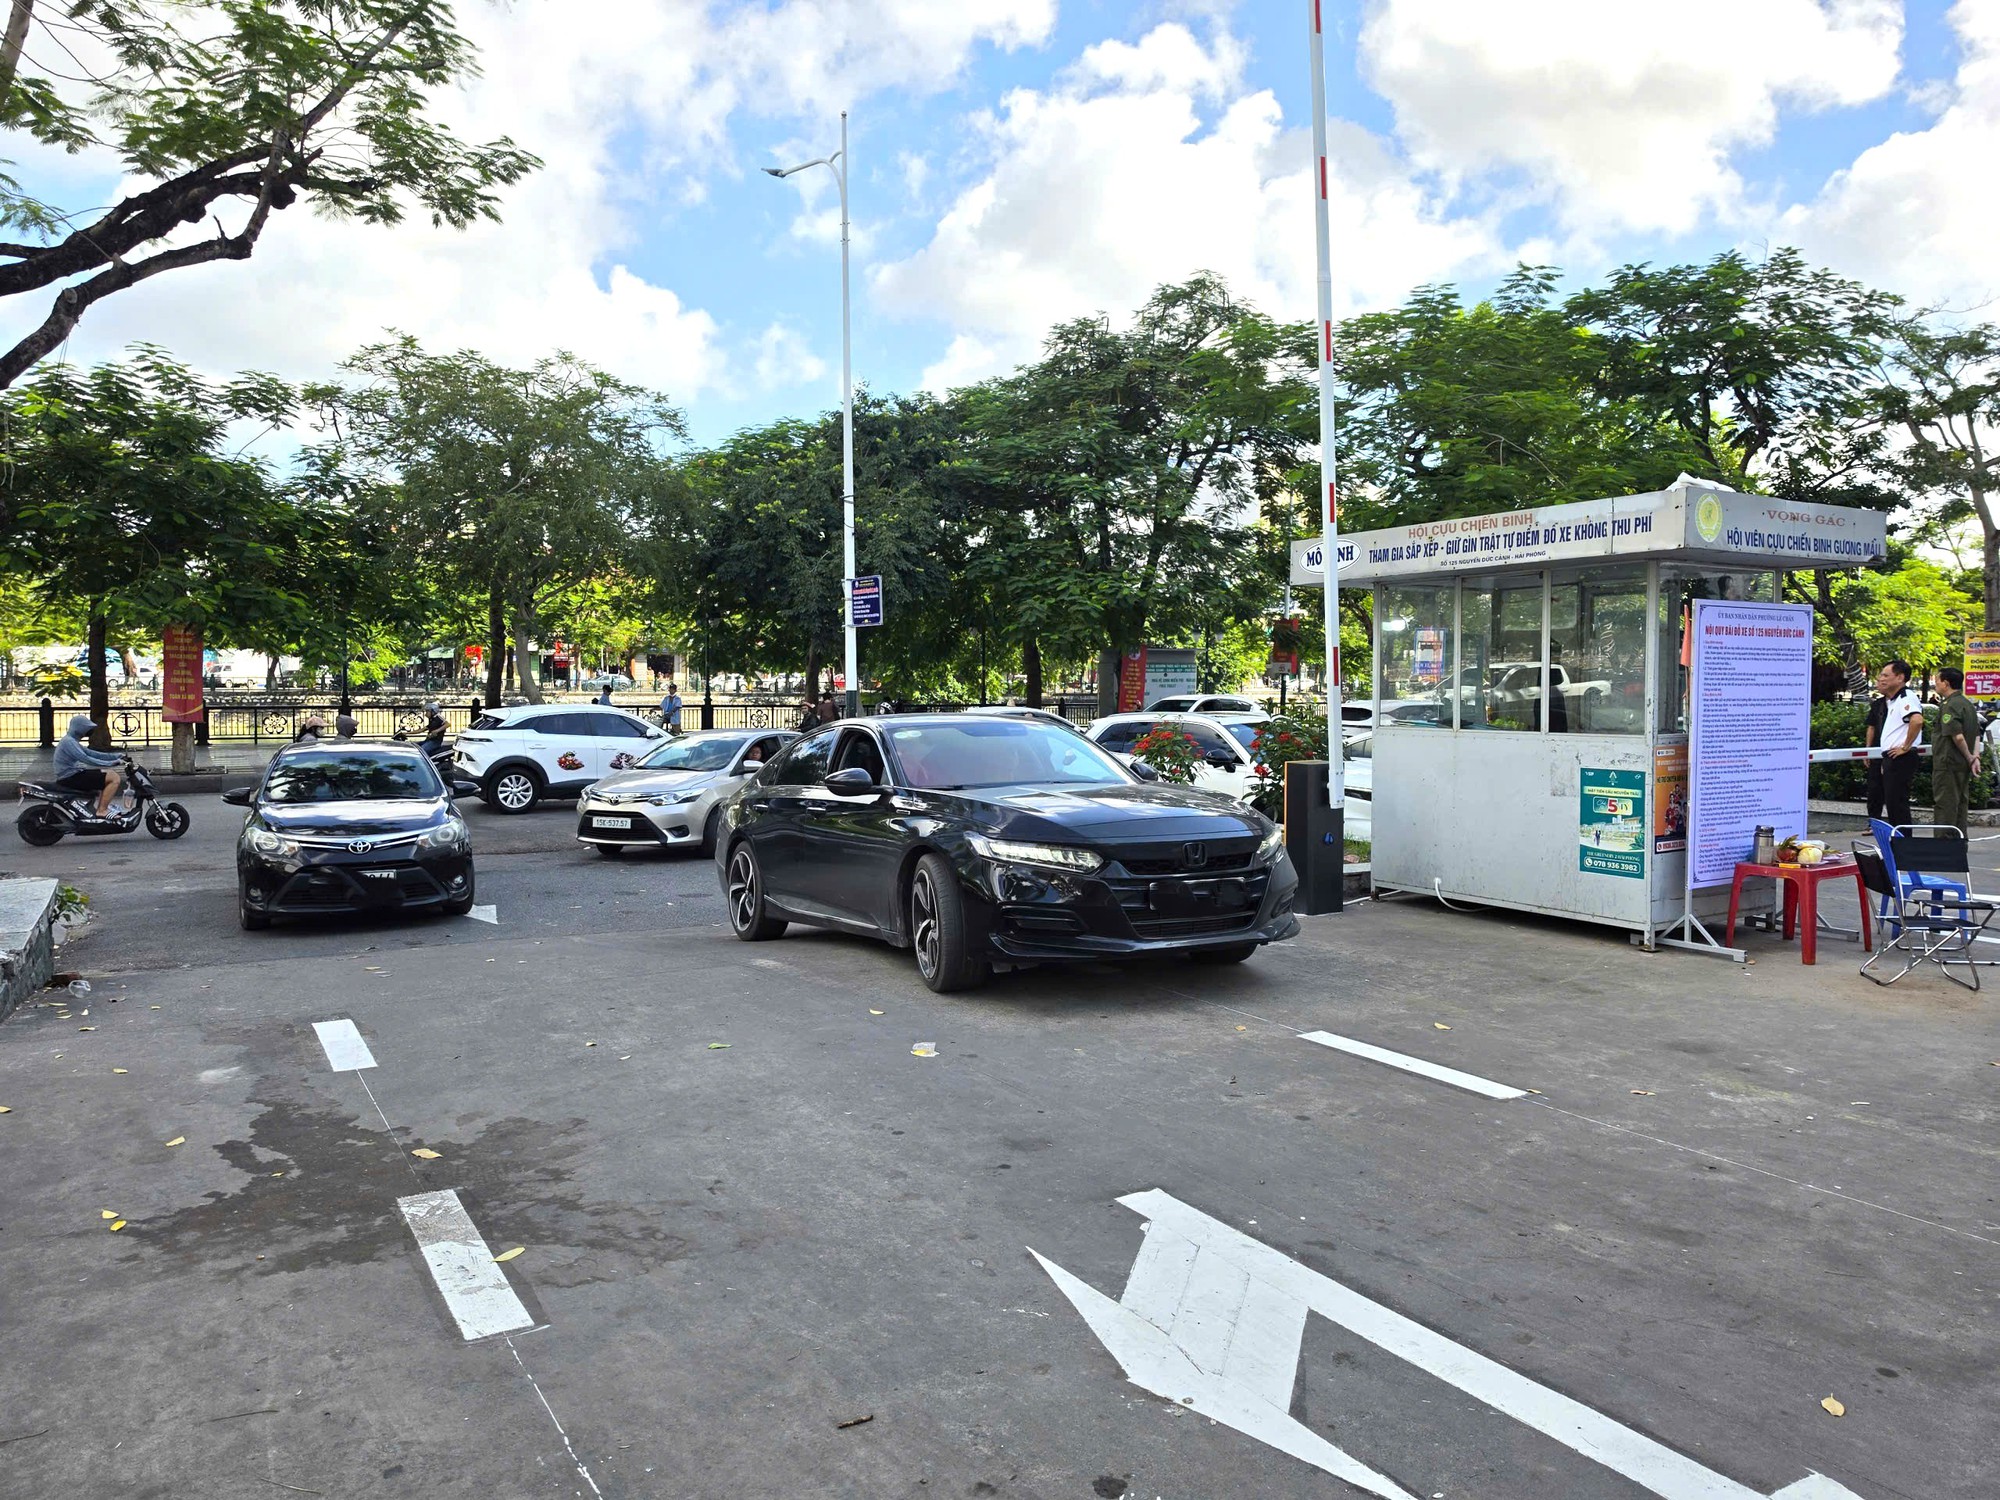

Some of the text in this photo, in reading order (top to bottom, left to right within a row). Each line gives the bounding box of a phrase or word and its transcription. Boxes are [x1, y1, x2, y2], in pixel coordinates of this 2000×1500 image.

[1408, 512, 1533, 540] HỘI CỰU CHIẾN BINH
[1766, 509, 1845, 527] VỌNG GÁC
[1368, 548, 1389, 564] THAM
[1391, 546, 1404, 561] GIA
[1405, 540, 1421, 560] SẮP
[1423, 538, 1439, 558] XẾP
[1446, 536, 1461, 556] GIỮ
[1462, 535, 1477, 553] GÌN
[1479, 532, 1501, 553] TRẬT
[1503, 530, 1515, 551] TỰ
[1516, 524, 1540, 547] ĐIỂM
[1543, 522, 1558, 544] ĐỖ
[1559, 526, 1571, 543] XE
[1574, 520, 1608, 541] KHÔNG
[1611, 519, 1631, 537] THU
[1634, 512, 1653, 533] PHÍ
[1726, 527, 1743, 549] HỘI
[1744, 529, 1764, 548] VIÊN
[1766, 533, 1785, 553] CỰU
[1787, 531, 1811, 552] CHIẾN
[1813, 538, 1832, 554] BINH
[1833, 538, 1862, 556] GƯƠNG
[1306, 547, 1322, 567] MÔ
[1735, 612, 1747, 620] NHÂN
[1705, 623, 1805, 638] NỘI QUY BÃI ĐỖ XE SỐ 125 NGUYỄN ĐỨC CẢNH
[1607, 799, 1618, 813] 5
[1593, 860, 1638, 872] 078 936 3982
